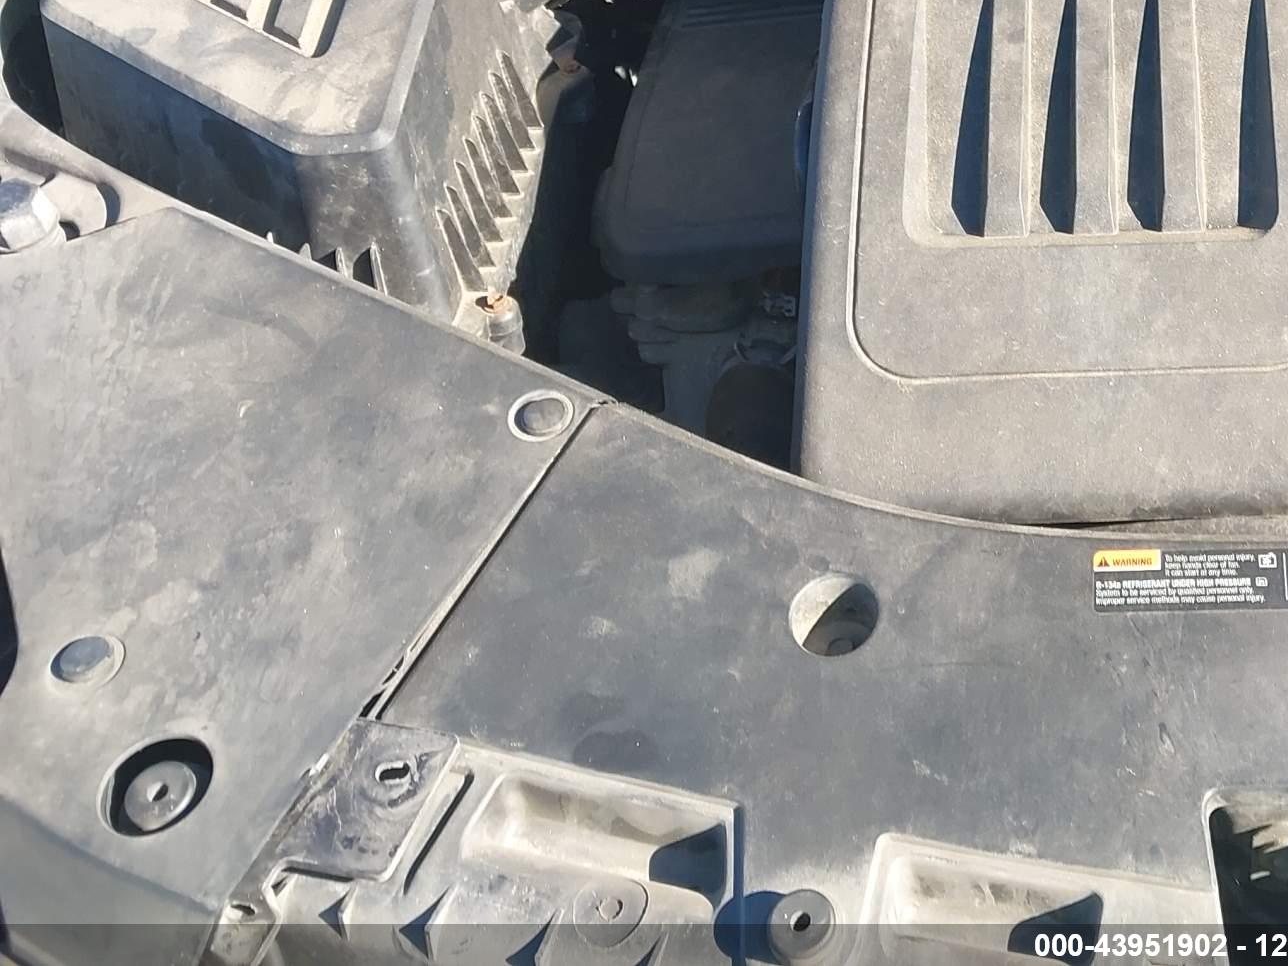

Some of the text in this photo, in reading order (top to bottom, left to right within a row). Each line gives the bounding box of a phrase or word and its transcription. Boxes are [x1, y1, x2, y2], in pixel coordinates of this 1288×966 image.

[1113, 558, 1152, 566] WARNING
[1165, 554, 1173, 562] To
[1173, 554, 1188, 563] help
[1189, 554, 1206, 562] avoid
[1207, 554, 1235, 563] personal
[1165, 562, 1181, 570] keep
[1220, 561, 1227, 569] of
[1208, 569, 1220, 577] any
[1096, 578, 1251, 589] R-134a REFRIGERANT UNDER HIGH PRESSURE
[1096, 589, 1120, 598] System
[1140, 588, 1166, 596] serviced
[1167, 588, 1177, 597] by
[1178, 588, 1206, 596] qualified
[1206, 587, 1238, 595] personnel
[1096, 597, 1125, 606] Improper
[1151, 596, 1180, 604] methods
[1181, 596, 1195, 604] may
[1216, 595, 1245, 604] personal
